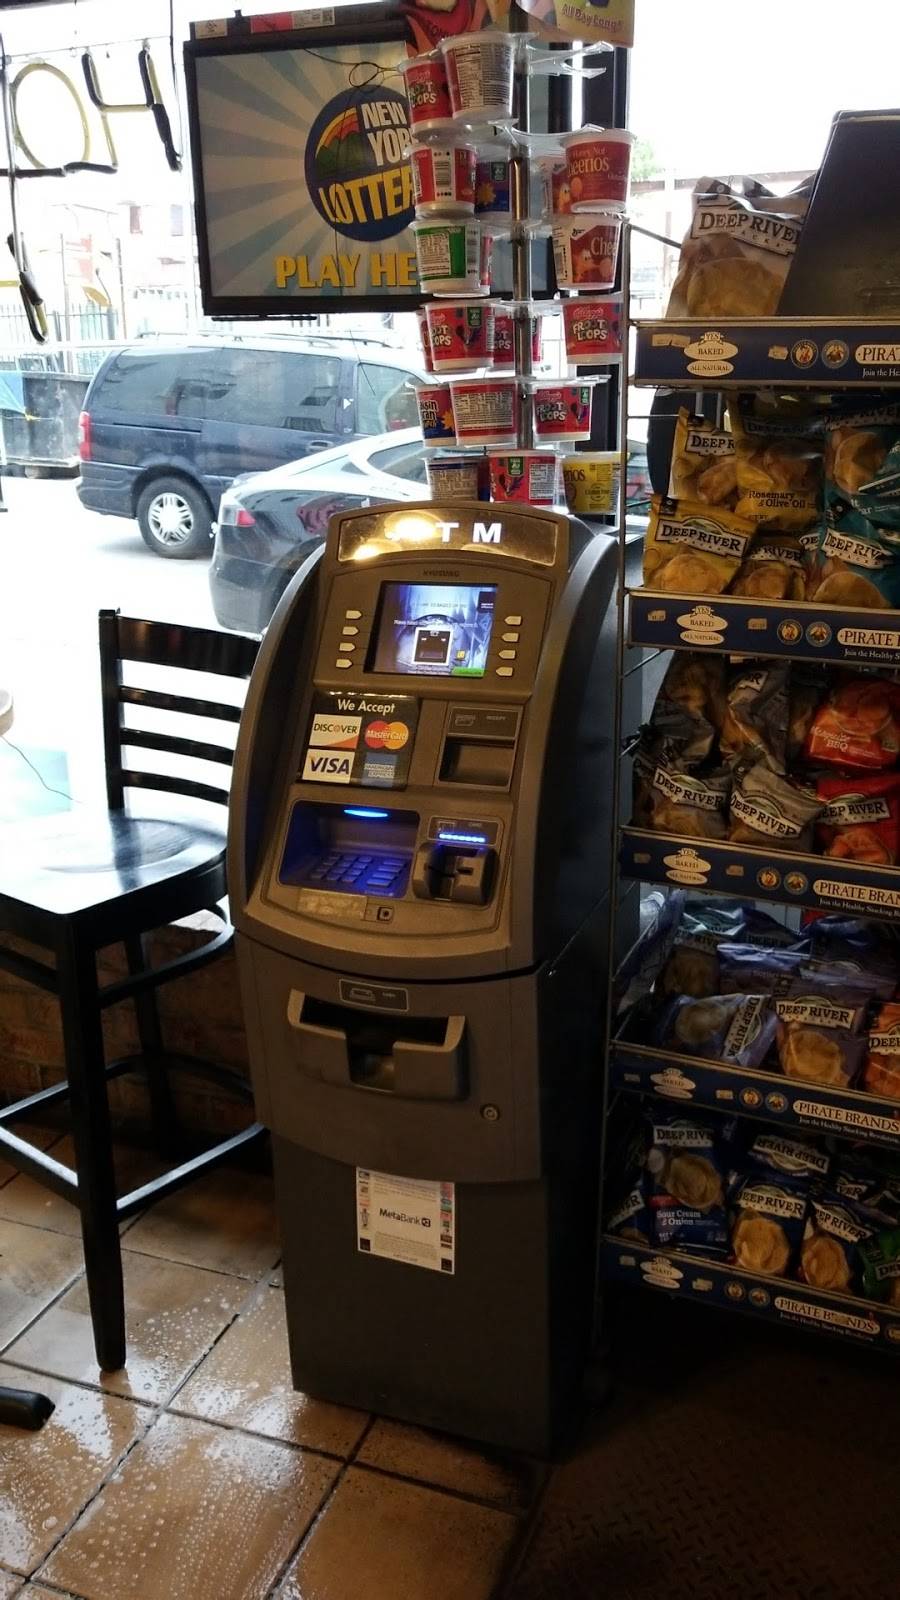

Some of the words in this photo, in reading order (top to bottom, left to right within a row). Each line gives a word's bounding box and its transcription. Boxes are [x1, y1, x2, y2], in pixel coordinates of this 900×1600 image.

[361, 101, 407, 129] NEW
[699, 212, 749, 231] DEEP
[275, 254, 360, 288] PLAY
[698, 348, 724, 357] BAKED
[691, 436, 726, 448] DEEP
[749, 491, 796, 502] Rosemary
[662, 524, 697, 539] DEEP
[698, 530, 742, 553] RIVER
[844, 630, 893, 646] PIRATE
[338, 699, 355, 711] We
[358, 701, 395, 716] Accept
[314, 723, 358, 735] DISCOVER
[310, 757, 350, 775] VISA
[656, 772, 683, 795] DEEP
[847, 801, 886, 816] RIVER
[819, 882, 865, 900] PIRATE
[779, 1004, 807, 1016] DEEP
[808, 1006, 850, 1024] RIVER
[799, 1102, 843, 1120] PIRATE
[845, 1112, 900, 1132] BRANDS
[656, 1129, 685, 1140] DEEP
[765, 1196, 803, 1215] RIVER
[380, 1207, 422, 1225] MetaBank
[779, 1299, 821, 1317] PIRATE
[823, 1310, 875, 1331] BNDS
